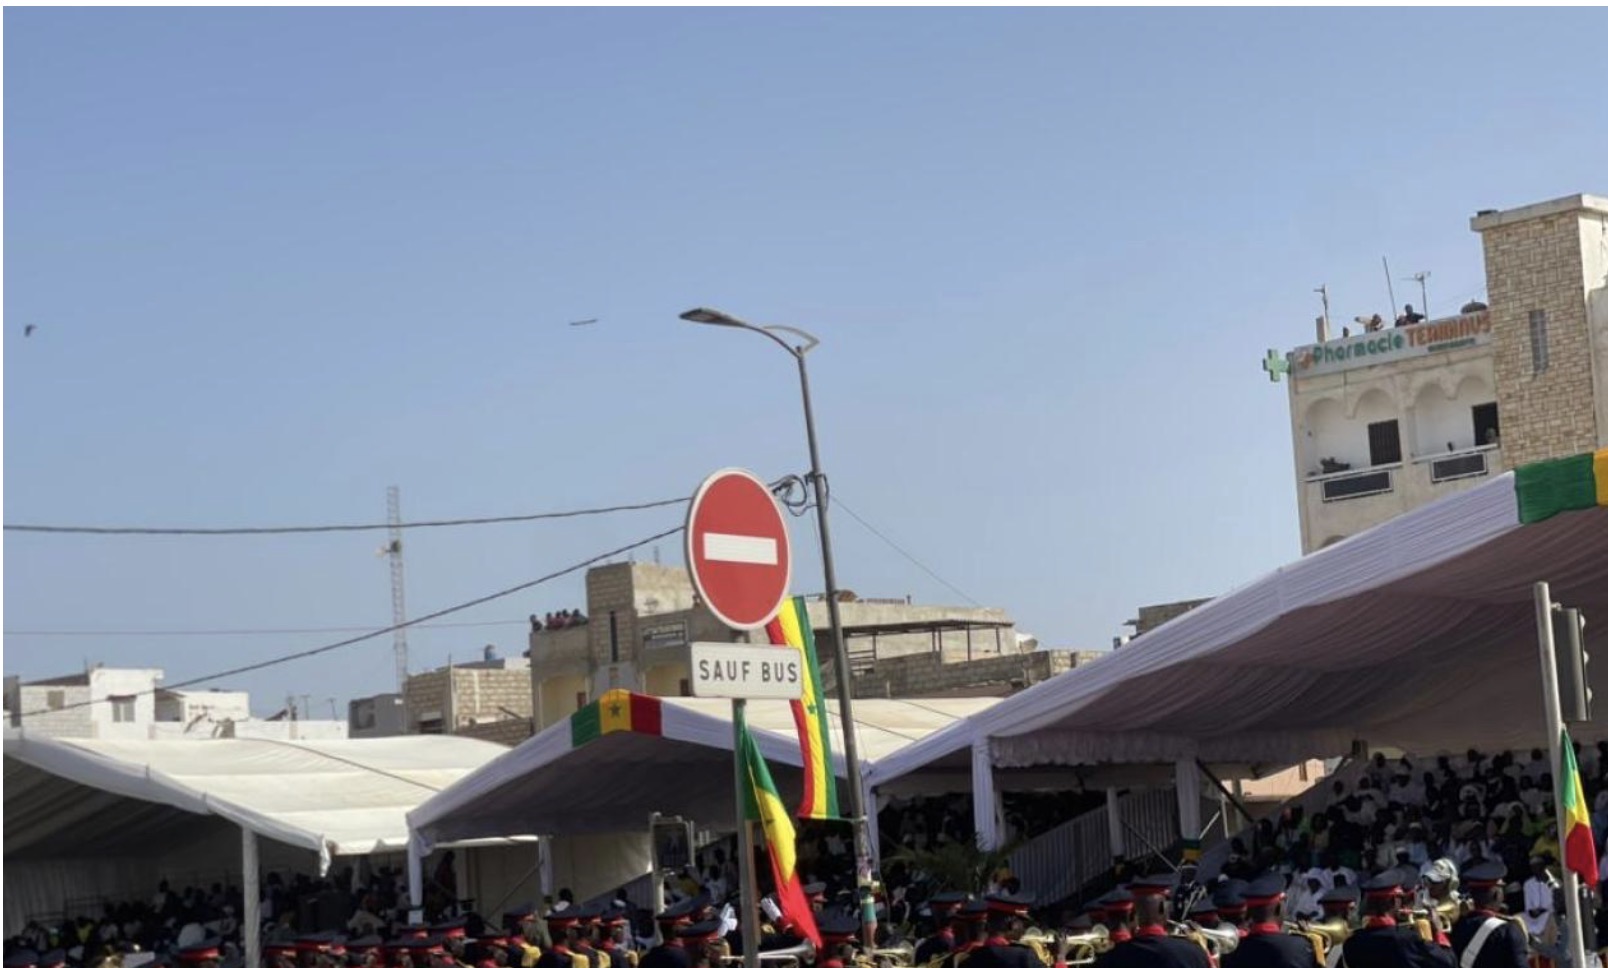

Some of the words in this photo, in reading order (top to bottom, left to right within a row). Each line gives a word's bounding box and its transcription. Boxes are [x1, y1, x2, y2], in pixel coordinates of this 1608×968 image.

[1313, 332, 1404, 364] Pharmacie
[699, 659, 750, 682] SAUF
[761, 661, 798, 683] BUS
